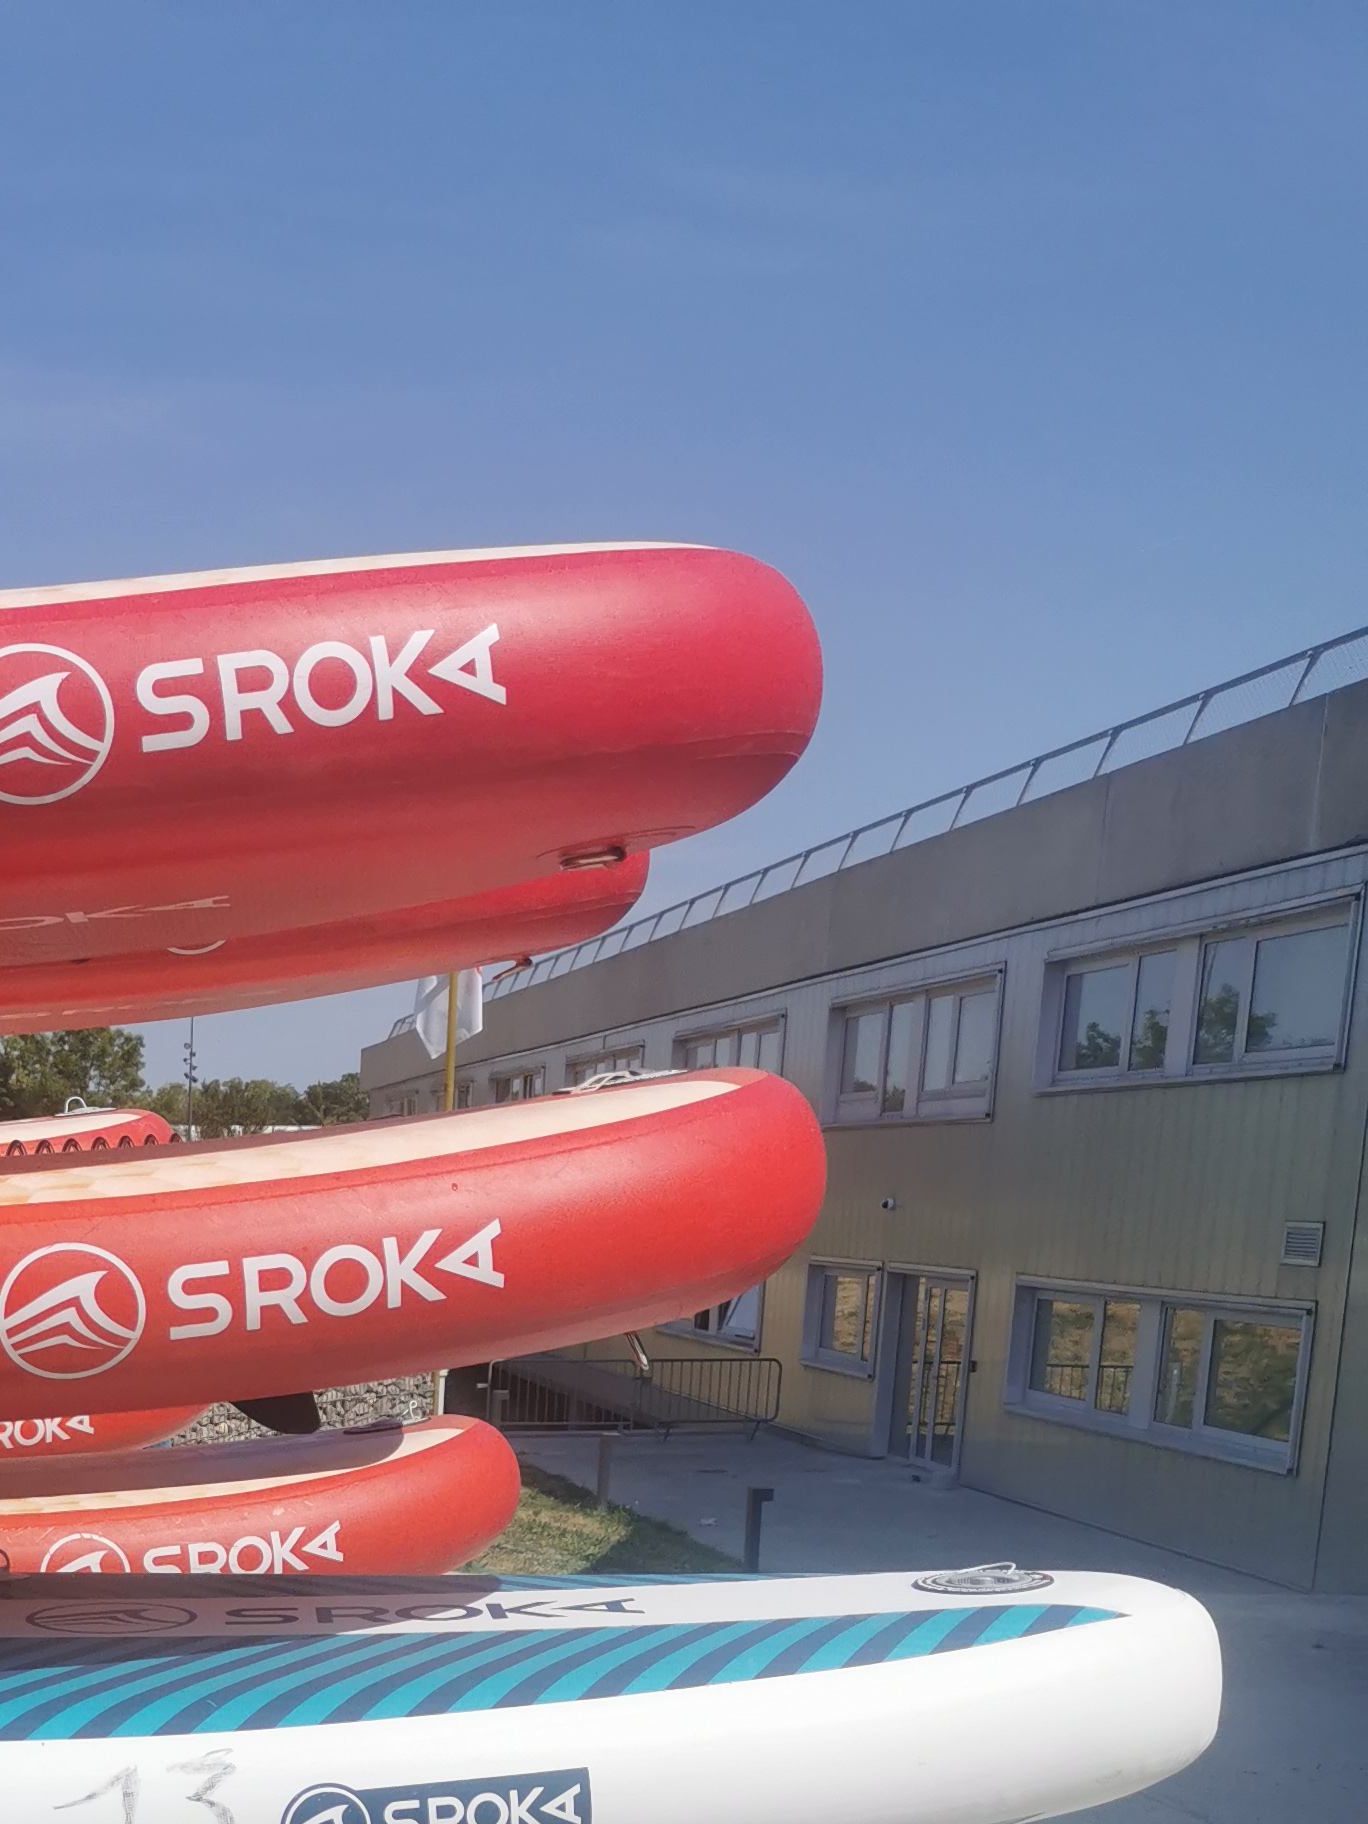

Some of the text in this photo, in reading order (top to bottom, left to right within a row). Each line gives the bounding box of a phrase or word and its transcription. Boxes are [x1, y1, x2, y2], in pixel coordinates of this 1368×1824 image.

[135, 622, 508, 753] SROKA
[167, 1218, 506, 1341] SROKA
[224, 1597, 647, 1627] SROKA
